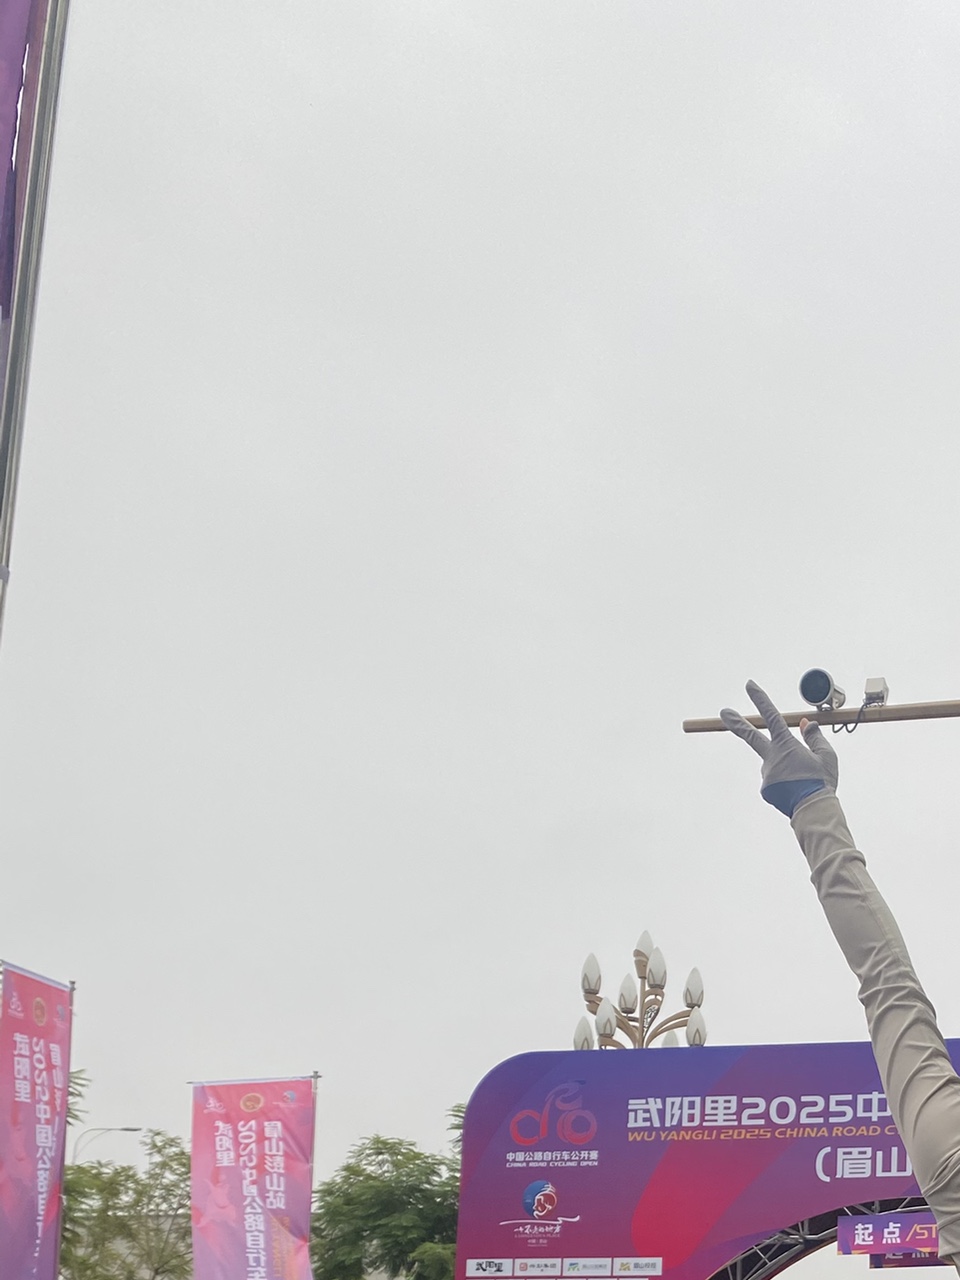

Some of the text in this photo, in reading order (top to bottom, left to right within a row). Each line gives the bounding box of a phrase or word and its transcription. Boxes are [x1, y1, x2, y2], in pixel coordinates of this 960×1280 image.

[628, 1131, 656, 1141] WU
[659, 1130, 716, 1141] YANGLI
[720, 1129, 771, 1139] 2025
[775, 1127, 827, 1138] CHINA
[832, 1126, 881, 1136] ROAD
[506, 1150, 598, 1162] 中国公路自行车公开赛
[815, 1146, 912, 1182] (眉山
[854, 1222, 901, 1245] 起点
